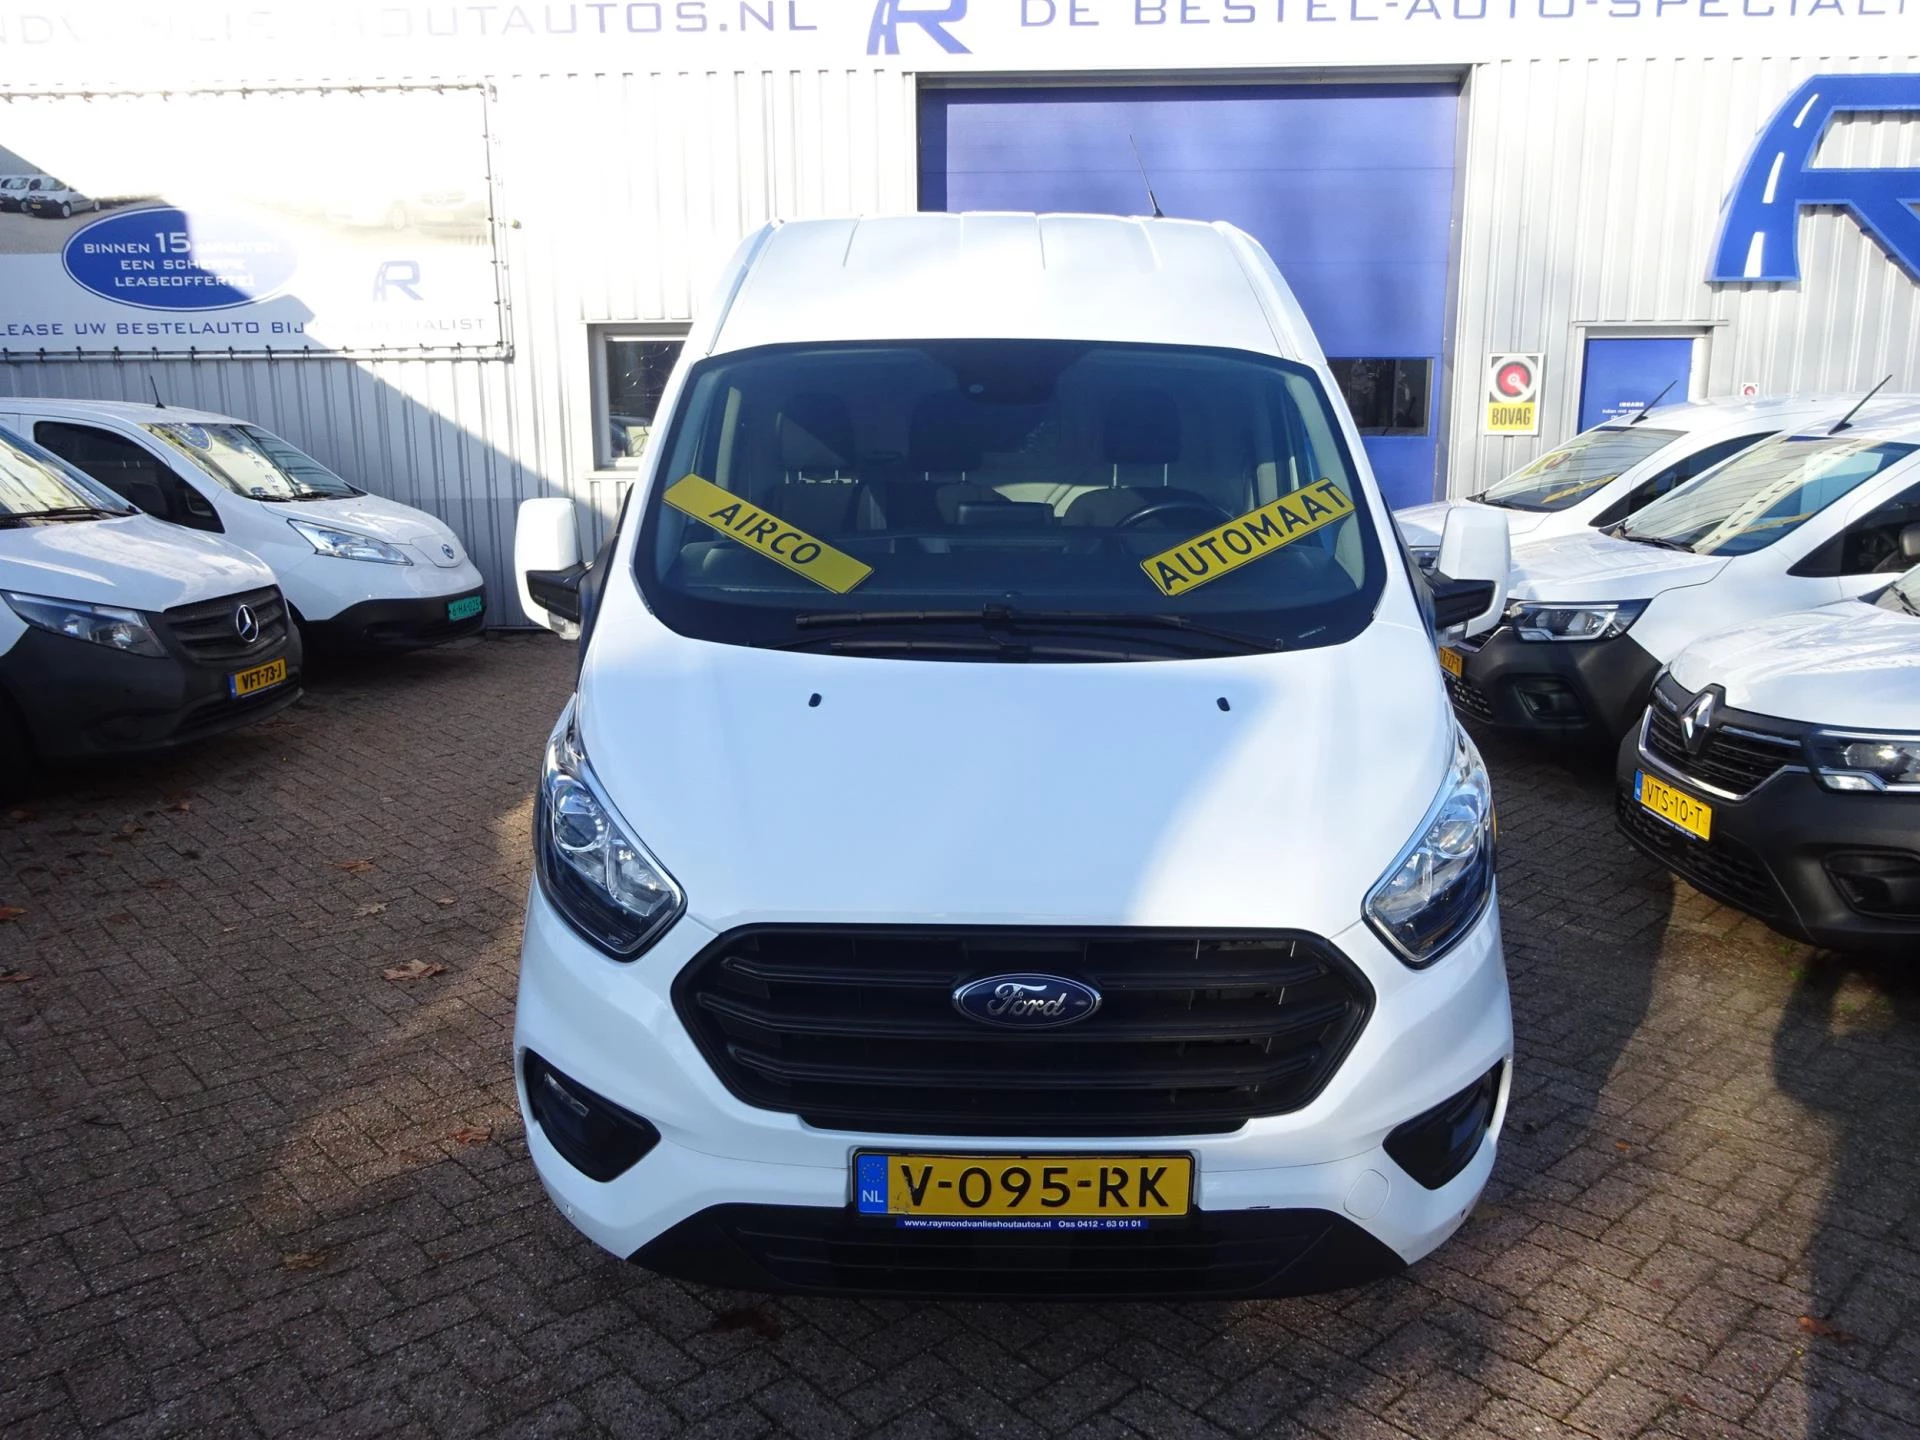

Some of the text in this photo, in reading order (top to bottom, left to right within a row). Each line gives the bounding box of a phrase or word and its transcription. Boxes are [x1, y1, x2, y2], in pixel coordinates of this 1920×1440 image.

[1021, 0, 1099, 27] DE
[84, 243, 150, 254] BINNEN
[155, 231, 191, 254] 15
[121, 260, 155, 270] EEN
[75, 323, 106, 335] UW
[117, 322, 259, 335] BESTELAUTO
[271, 322, 305, 334] BIJ
[1491, 406, 1532, 427] BOVAG
[708, 503, 821, 564] AIRCO
[1155, 482, 1346, 591] AUTOMAAT
[1647, 779, 1703, 829] VTS-10-T
[987, 983, 1067, 1016] Ford
[862, 1189, 884, 1203] NL
[900, 1164, 1169, 1209] V-095-RK
[904, 1220, 1052, 1229] www.raymondvanlieshoutautos.nl
[1058, 1220, 1076, 1228] Oss
[1077, 1220, 1098, 1228] 0412
[1106, 1220, 1117, 1228] 63
[1119, 1220, 1129, 1228] 01
[1131, 1220, 1141, 1228] 01
